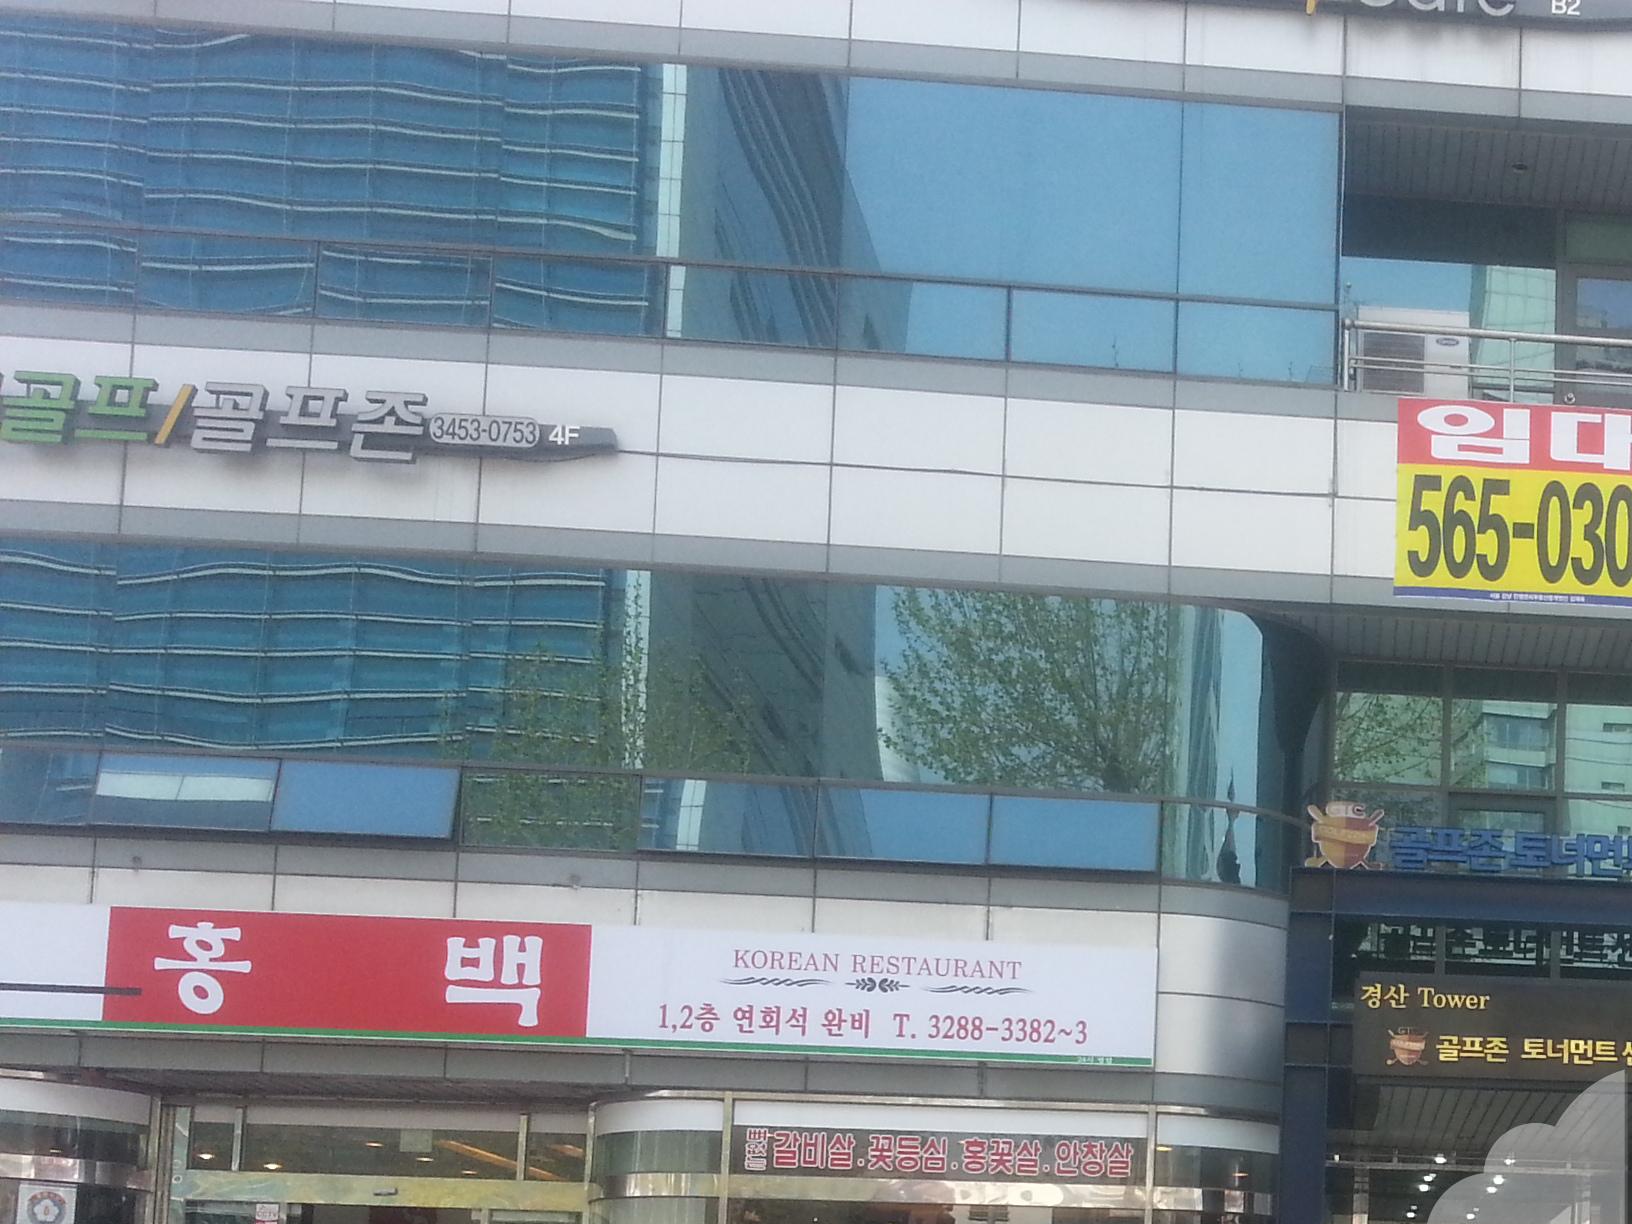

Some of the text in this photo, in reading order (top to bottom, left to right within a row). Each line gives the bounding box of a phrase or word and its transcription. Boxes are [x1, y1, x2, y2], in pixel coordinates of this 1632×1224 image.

[431, 414, 538, 445] 3453-0753
[548, 424, 580, 446] 4F
[1389, 826, 1505, 871] 골프존
[732, 948, 1023, 980] KOREAN RESTAURANT
[1360, 983, 1490, 1010] 경산 Tower
[658, 1002, 1090, 1045] 1,2층 연회석 완비 T. 3288-3382~3
[1435, 1034, 1510, 1063] 골프존
[1520, 1038, 1619, 1066] 토너먼트
[772, 1130, 856, 1170] 갈비살
[867, 1135, 949, 1173] 꽃등심
[961, 1138, 1041, 1176] 홍꽃살
[1054, 1140, 1134, 1178] 안창살
